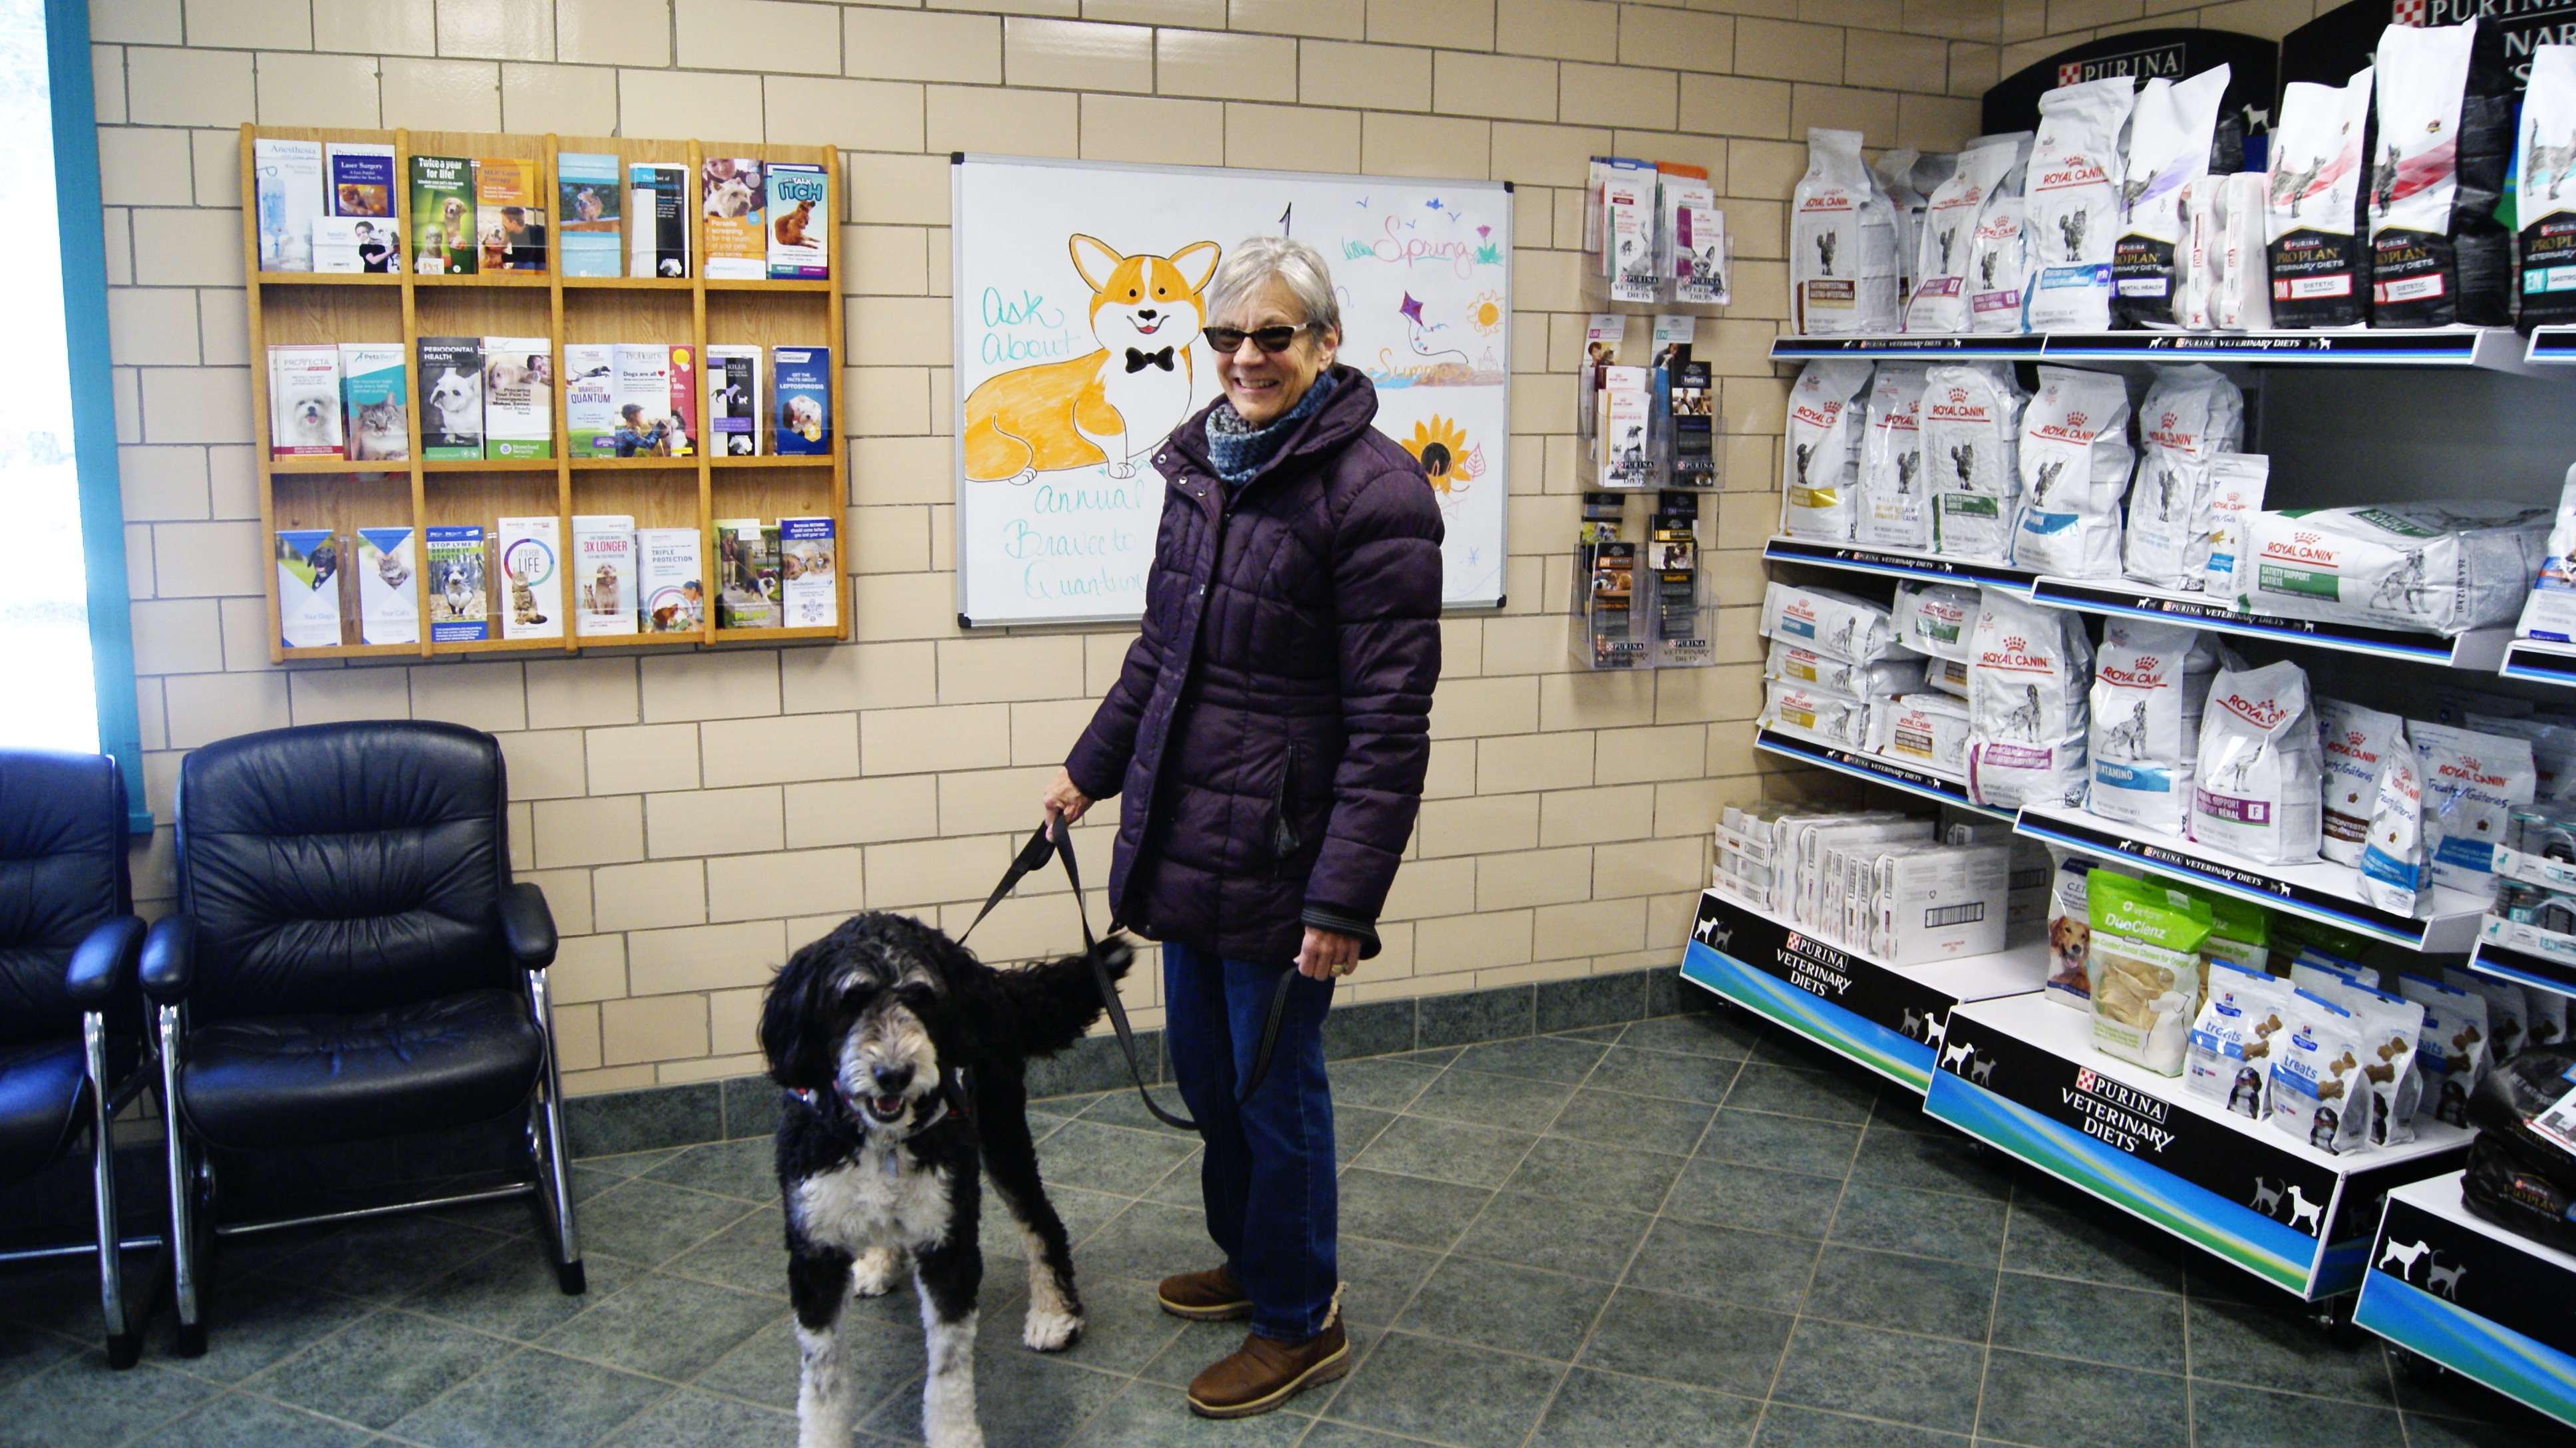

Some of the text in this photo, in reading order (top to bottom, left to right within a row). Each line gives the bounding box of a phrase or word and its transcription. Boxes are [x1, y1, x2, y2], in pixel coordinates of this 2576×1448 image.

[2084, 51, 2179, 81] PURINA
[271, 144, 316, 154] Anesthesia
[359, 162, 383, 170] Surgery
[418, 157, 438, 168] Twice
[446, 160, 462, 170] year
[426, 169, 454, 179] for life!
[2043, 171, 2072, 184] ROYAL
[778, 181, 823, 202] ITCH
[1373, 215, 1475, 279] Spring
[2291, 239, 2320, 248] PURINA
[2382, 238, 2407, 248] PURINA
[2531, 238, 2555, 252] PRO
[2128, 254, 2158, 264] PLAN
[2276, 248, 2338, 264] PRO PLAN
[2389, 247, 2426, 263] PLAN
[2317, 260, 2344, 269] DIETS
[1628, 275, 1658, 284] PURINA
[1690, 275, 1721, 285] PURINA
[2303, 280, 2334, 289] DIETETIC
[2396, 282, 2426, 291] DIETETIC
[2525, 272, 2544, 291] EN
[2275, 282, 2288, 299] DM
[1888, 340, 1923, 349] VETERINARY
[2219, 339, 2273, 349] VETERINARY
[1367, 347, 1470, 386] Summer
[571, 393, 611, 404] QUANTUM
[1797, 405, 1821, 423] ROYAL
[1933, 405, 1985, 417] ROYAL CANIN
[1884, 413, 1914, 426] ROYAL
[2042, 425, 2067, 437] ROYAL
[518, 548, 540, 557] IT'S FOR
[584, 540, 627, 552] 3X LONGER
[2268, 541, 2333, 561] ROYAL CANIN
[518, 557, 540, 573] LIFE
[1881, 556, 1916, 568] VETERINARY
[2261, 565, 2311, 582] SATIETY SUPPORT
[734, 611, 766, 621] PLAY
[2171, 603, 2284, 626] PURINA VETERINARY DIETS
[1983, 652, 2048, 667] ROYAL CANIN
[2103, 666, 2134, 682] ROYAL
[2228, 693, 2265, 723] ROYAL
[2327, 741, 2377, 763] ROYAL CANIN
[1871, 763, 1905, 779] VETERINARY
[1905, 772, 1922, 782] DIETS
[2438, 765, 2507, 788] ROYAL CANIN
[2213, 795, 2240, 808] SUPPORT
[2152, 849, 2262, 886] PURINA VETERINARY DIETS
[2105, 912, 2167, 940] DuoClenz
[1798, 938, 1844, 969] PURINA
[1776, 948, 1852, 996] VETERINARY
[1790, 970, 1827, 997] DIETS
[2205, 1020, 2242, 1043] treats
[2285, 1054, 2319, 1080] treats
[2094, 1077, 2162, 1120] PURINA
[2062, 1087, 2175, 1153] VETERINARY
[2083, 1115, 2138, 1153] DIETS
[2522, 1182, 2548, 1196] PURINA
